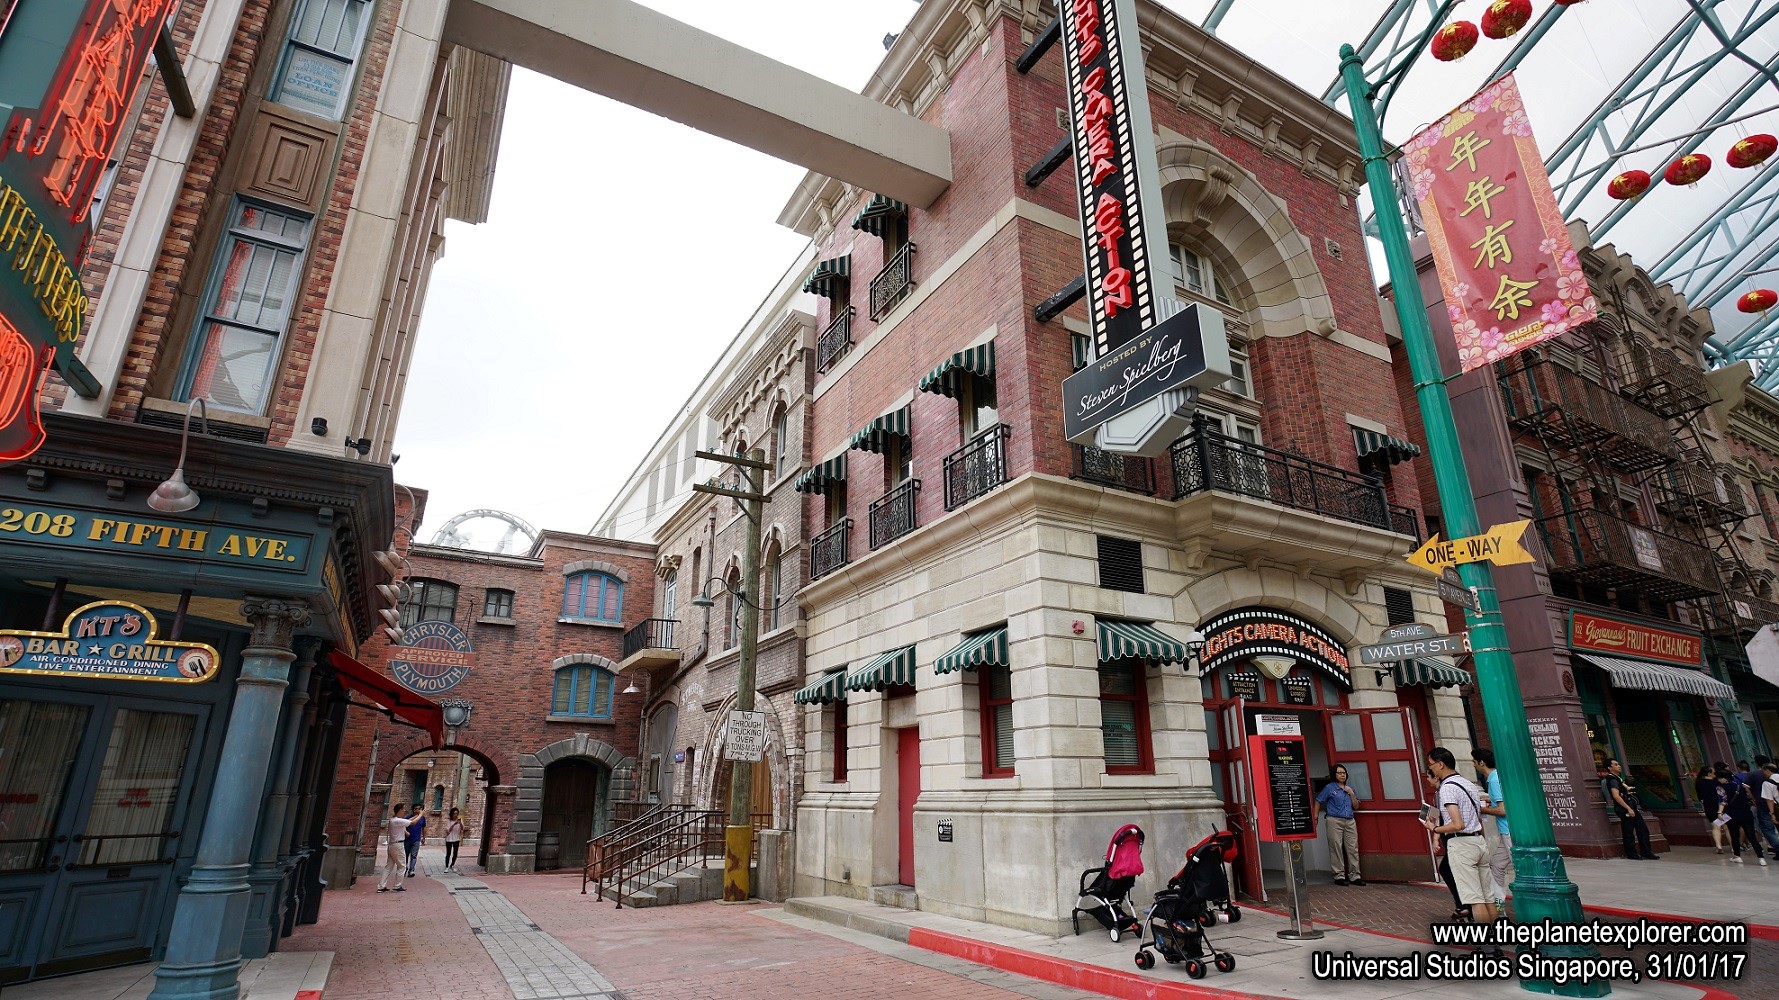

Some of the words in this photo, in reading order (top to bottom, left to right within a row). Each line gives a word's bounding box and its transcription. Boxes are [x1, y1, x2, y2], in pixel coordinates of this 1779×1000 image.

[1081, 66, 1117, 187] CAMERA
[1445, 130, 1540, 322] 年年有余
[1095, 192, 1132, 318] ACTION
[1099, 346, 1137, 372] HOSTED
[1139, 335, 1153, 349] BY
[1076, 383, 1119, 417] Steven
[1115, 334, 1183, 407] Spielberg
[0, 508, 77, 537] 208
[87, 518, 208, 552] FIFTH
[217, 534, 296, 563] AVE.
[1467, 536, 1502, 558] WAY
[76, 613, 142, 639] KT'S
[402, 624, 468, 651] CHRYSLER
[26, 637, 80, 656] BAR
[108, 642, 178, 663] GRILL
[401, 648, 464, 659] APPROVED
[1200, 625, 1244, 664] LIGHTS
[1243, 622, 1299, 645] CAMERA
[1368, 640, 1425, 660] WATER
[1429, 639, 1455, 652] ST.
[1627, 629, 1650, 650] FRUIT
[1650, 632, 1692, 658] EXCHANGE
[38, 662, 62, 671] LIVE
[68, 663, 159, 676] ENTERTAINMENT
[133, 660, 170, 671] DINING
[395, 653, 469, 665] SERVICE
[396, 663, 462, 690] PLYMOUTH
[732, 719, 762, 729] THROUGH
[742, 712, 753, 720] NO
[730, 727, 762, 737] TRUCKING
[735, 735, 755, 744] OVER
[1533, 746, 1563, 757] REIGHT
[1554, 796, 1577, 808] POINTS
